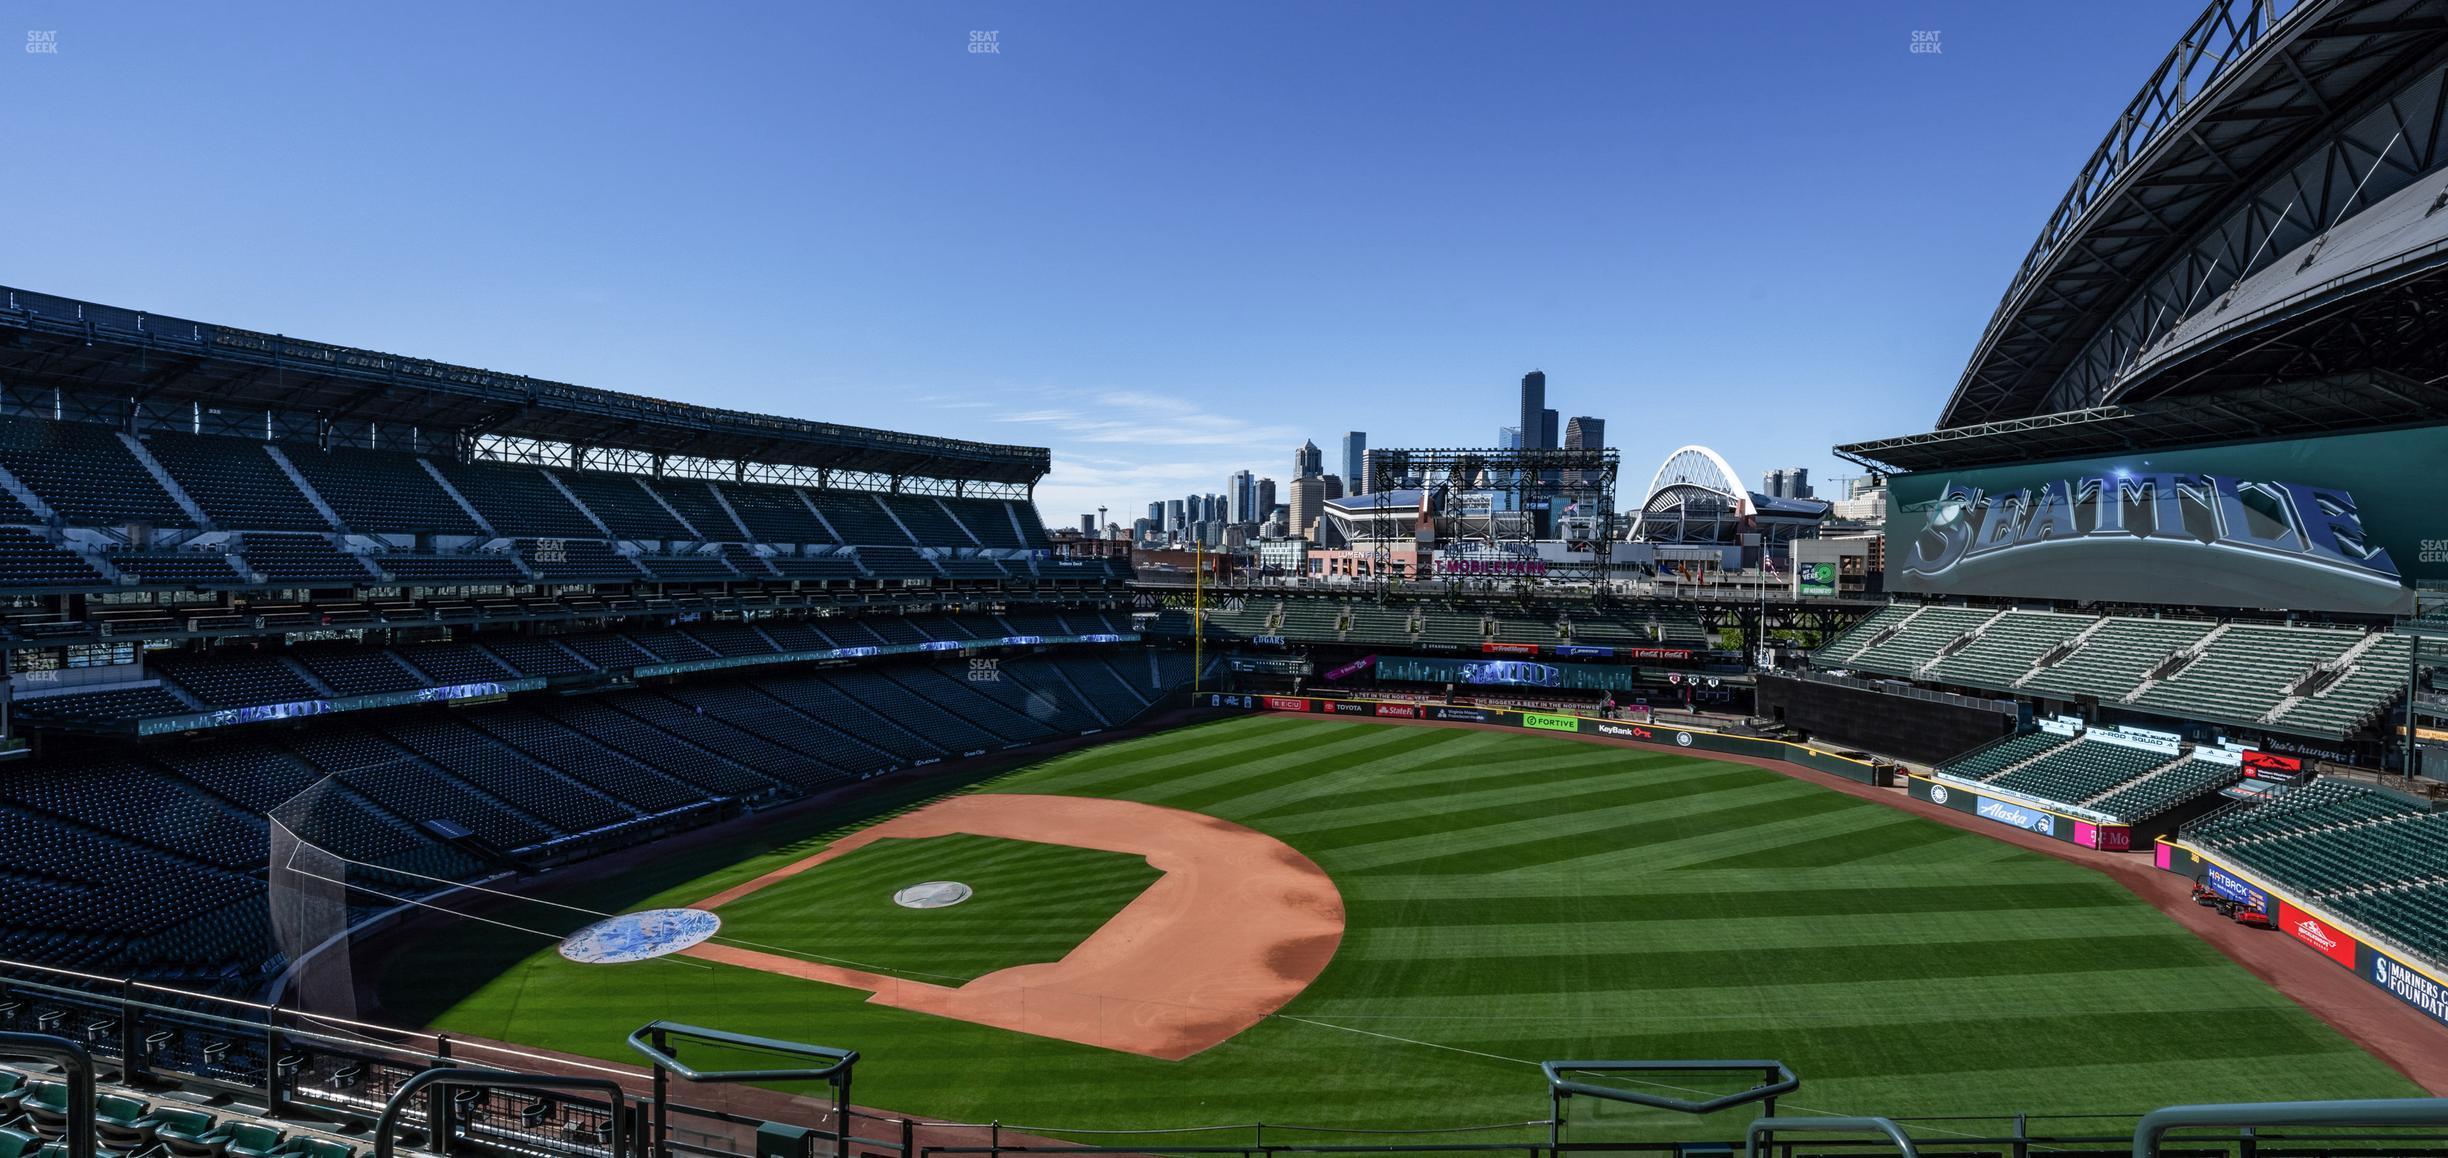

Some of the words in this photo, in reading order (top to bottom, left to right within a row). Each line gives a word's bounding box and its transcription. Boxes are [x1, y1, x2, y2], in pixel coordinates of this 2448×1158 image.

[1902, 474, 2402, 581] SEATTLE
[1338, 551, 1365, 559] LUMEN
[1506, 560, 1547, 573] PARK
[1336, 703, 1362, 712] TOYOTA
[1389, 706, 1424, 716] StateFa
[1563, 702, 1601, 711] NORTHWES
[1538, 718, 1575, 728] FORTIVE
[1598, 724, 1633, 736] KeyBank
[2099, 731, 2126, 740] J-ROD
[2131, 736, 2163, 746] SQUAD
[1980, 801, 2028, 825] Alaska
[2209, 868, 2248, 898] HATBACK
[2391, 962, 2438, 999] MARINERS
